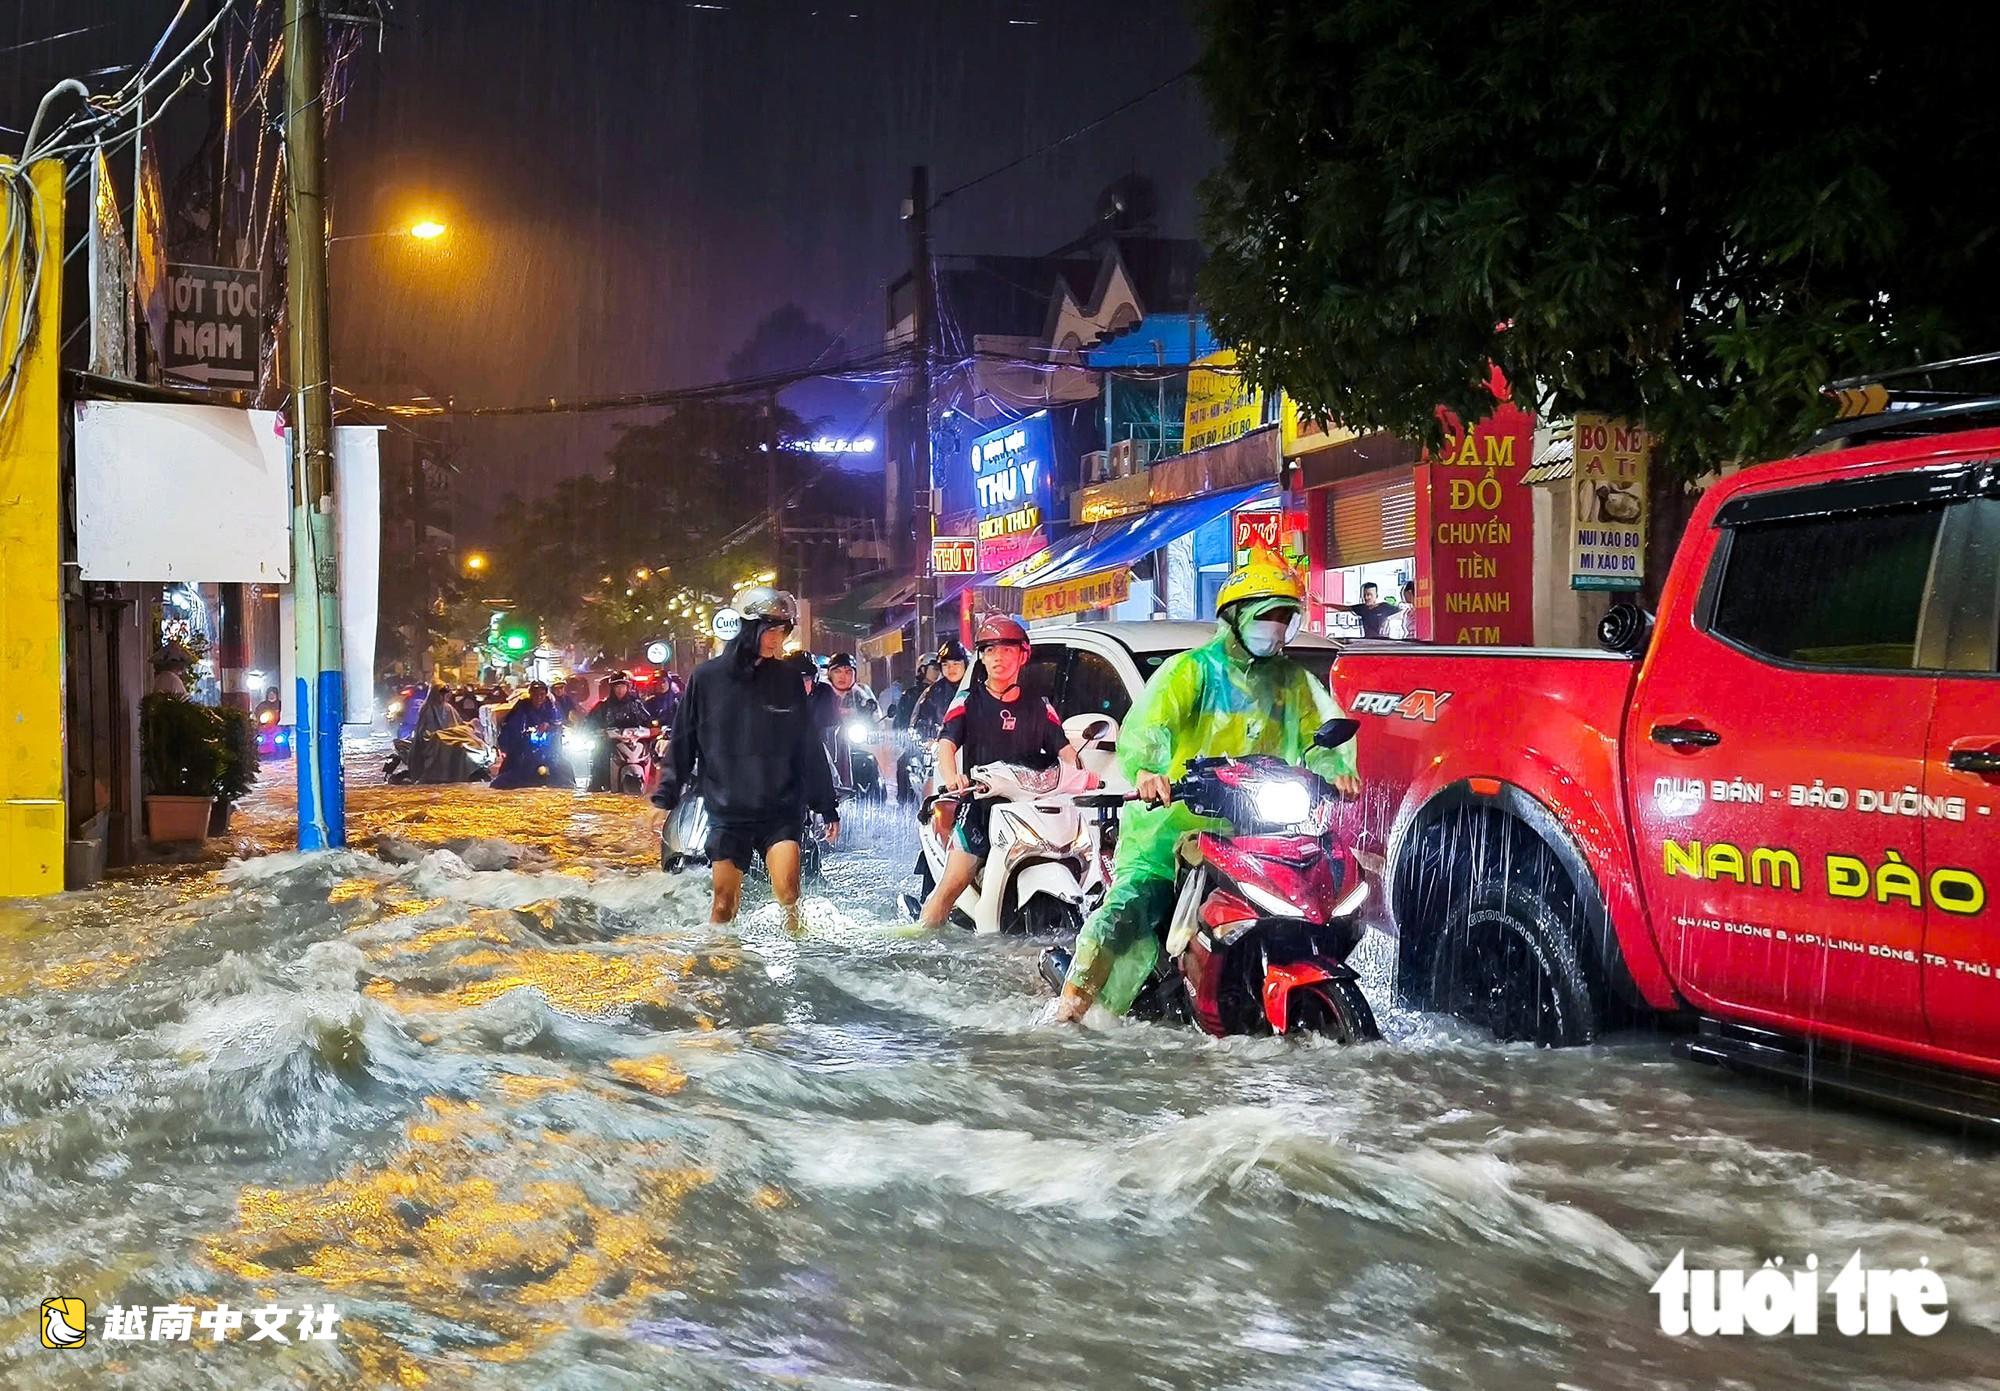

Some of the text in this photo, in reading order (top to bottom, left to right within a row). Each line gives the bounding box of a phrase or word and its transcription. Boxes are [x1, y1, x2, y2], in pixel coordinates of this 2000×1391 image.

[213, 274, 257, 318] TÓC
[174, 320, 242, 360] NAM
[1438, 421, 1516, 467] CẦM
[1579, 418, 1643, 453] BÒ NÉ
[1585, 455, 1606, 476] A
[976, 457, 1038, 508] THÚ Y
[1449, 466, 1502, 510] ĐỒ
[1437, 514, 1511, 544] CHUYỂN
[1578, 530, 1597, 546] NUI
[934, 541, 961, 572] THÚ
[962, 547, 975, 572] Y
[1457, 551, 1497, 579] TIỀN
[1445, 591, 1510, 613] NHANH
[1456, 626, 1500, 644] ATM
[1654, 777, 1706, 801] MUA
[1710, 775, 1764, 805] BÁN
[1788, 777, 1850, 810] BẢO
[1663, 839, 1986, 914] NAM ĐÀO
[1828, 938, 1865, 953] LINH
